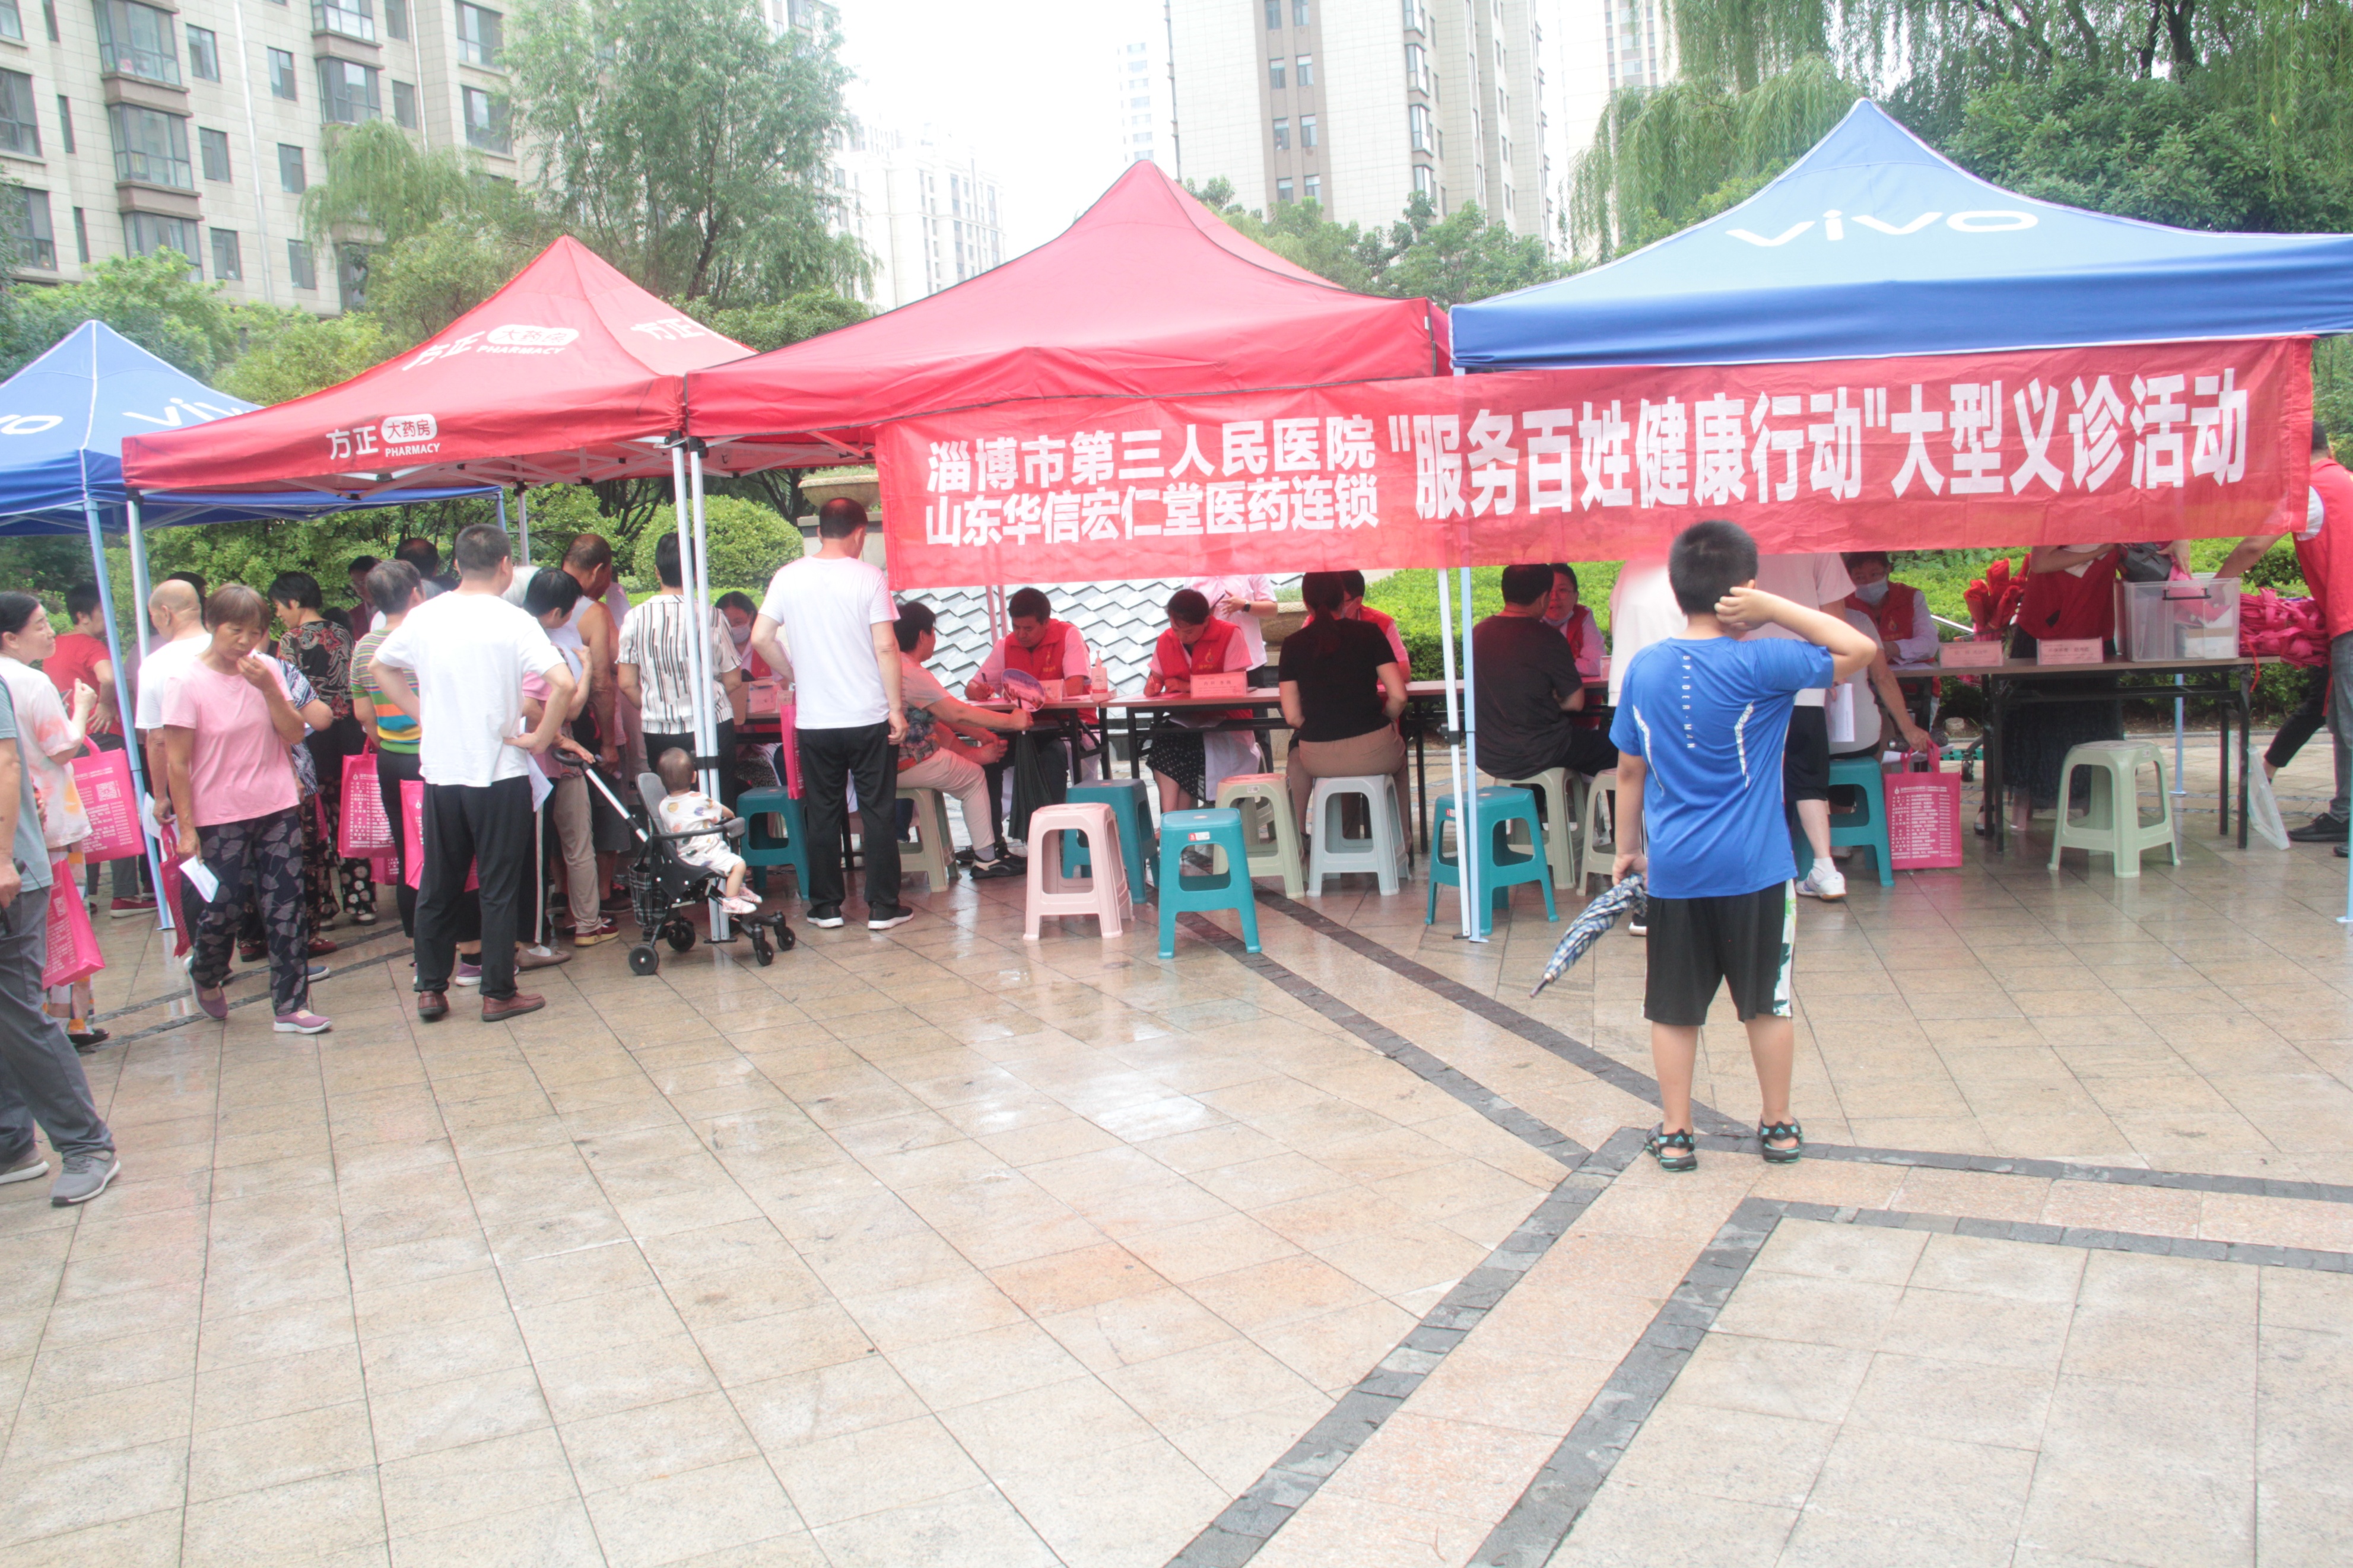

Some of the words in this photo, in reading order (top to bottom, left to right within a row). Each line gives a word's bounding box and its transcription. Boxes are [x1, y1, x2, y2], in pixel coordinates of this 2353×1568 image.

[1726, 209, 2039, 247] vivo
[630, 318, 706, 341] 方正
[402, 330, 486, 371] 方正
[496, 330, 567, 342] 大药房
[477, 345, 566, 355] PHARMACY
[122, 397, 250, 427] viv
[326, 425, 379, 460] 方正
[388, 419, 430, 439] 大药房
[385, 443, 440, 457] PHARMACY
[927, 414, 1376, 494] 淄博市第三人民医院
[925, 473, 1380, 548] 山东华信宏仁堂医药连锁
